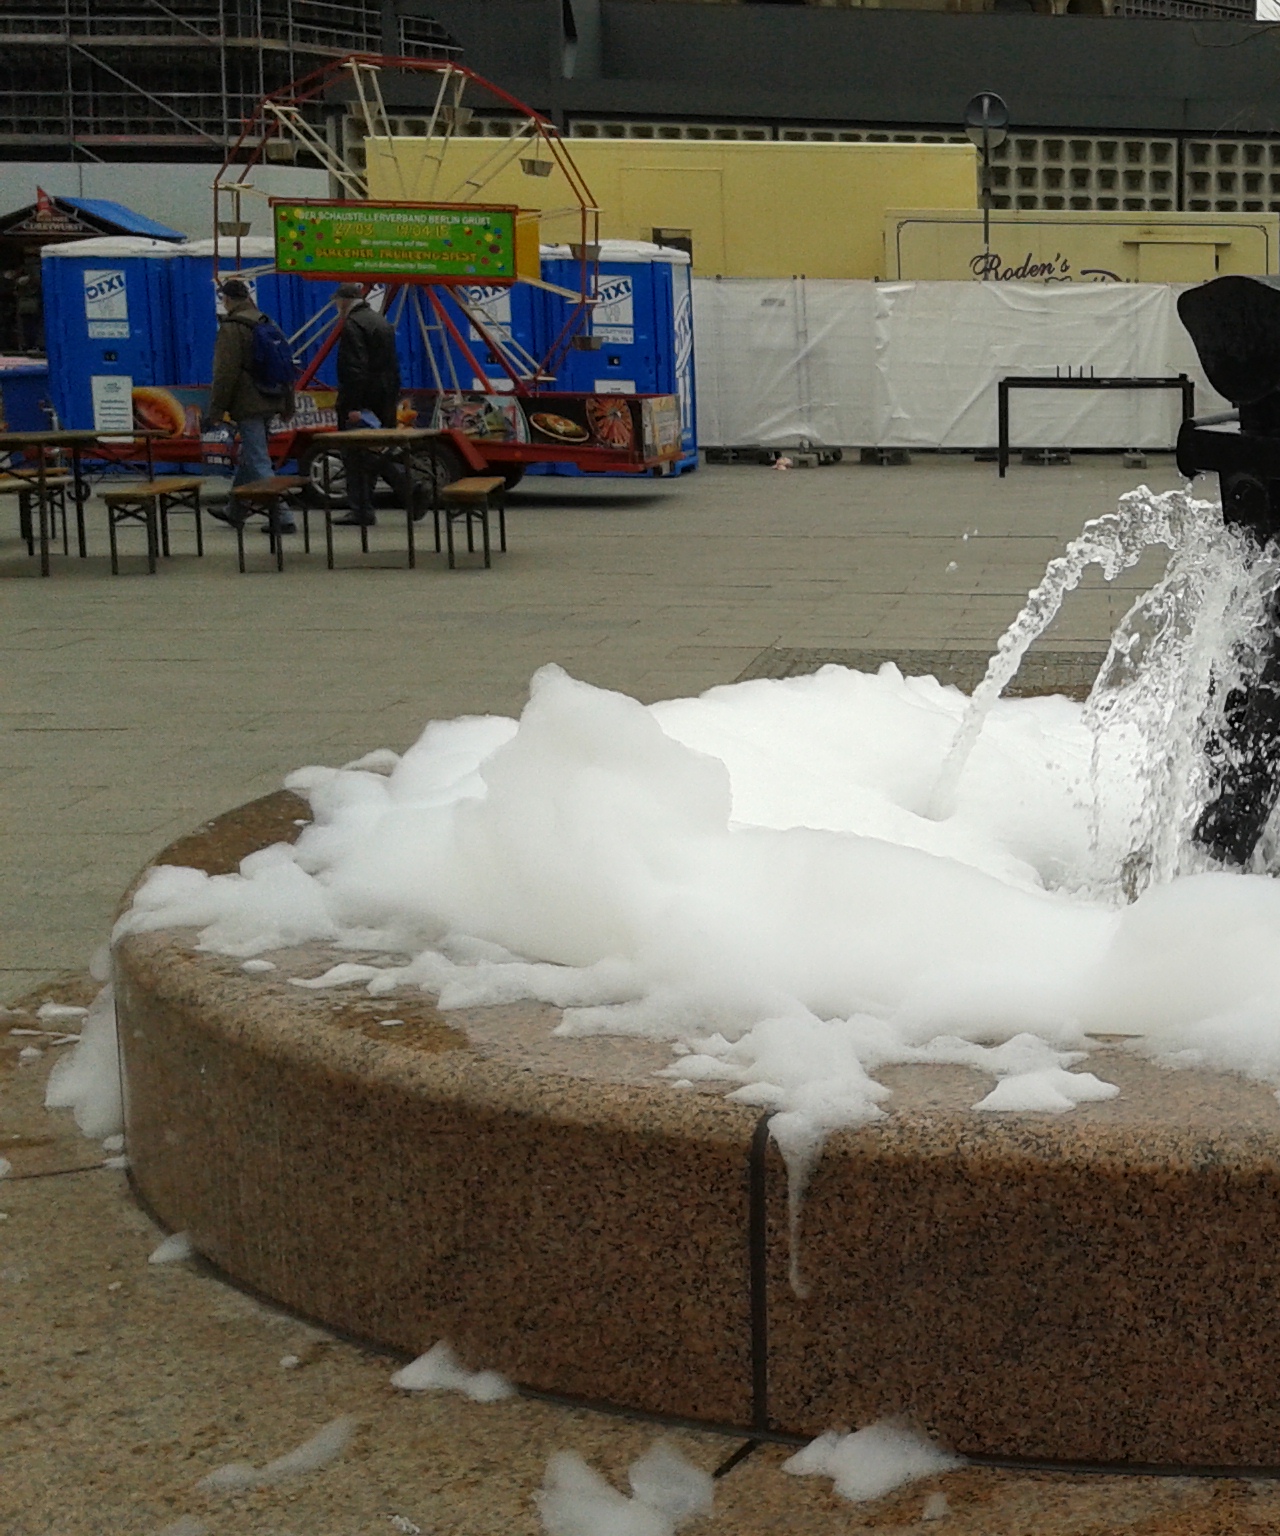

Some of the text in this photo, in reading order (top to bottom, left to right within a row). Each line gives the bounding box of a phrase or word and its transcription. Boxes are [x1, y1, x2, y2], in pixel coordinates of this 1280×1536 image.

[428, 214, 460, 224] BERLIN
[970, 252, 1070, 281] Roden's
[85, 275, 124, 300] DIXI
